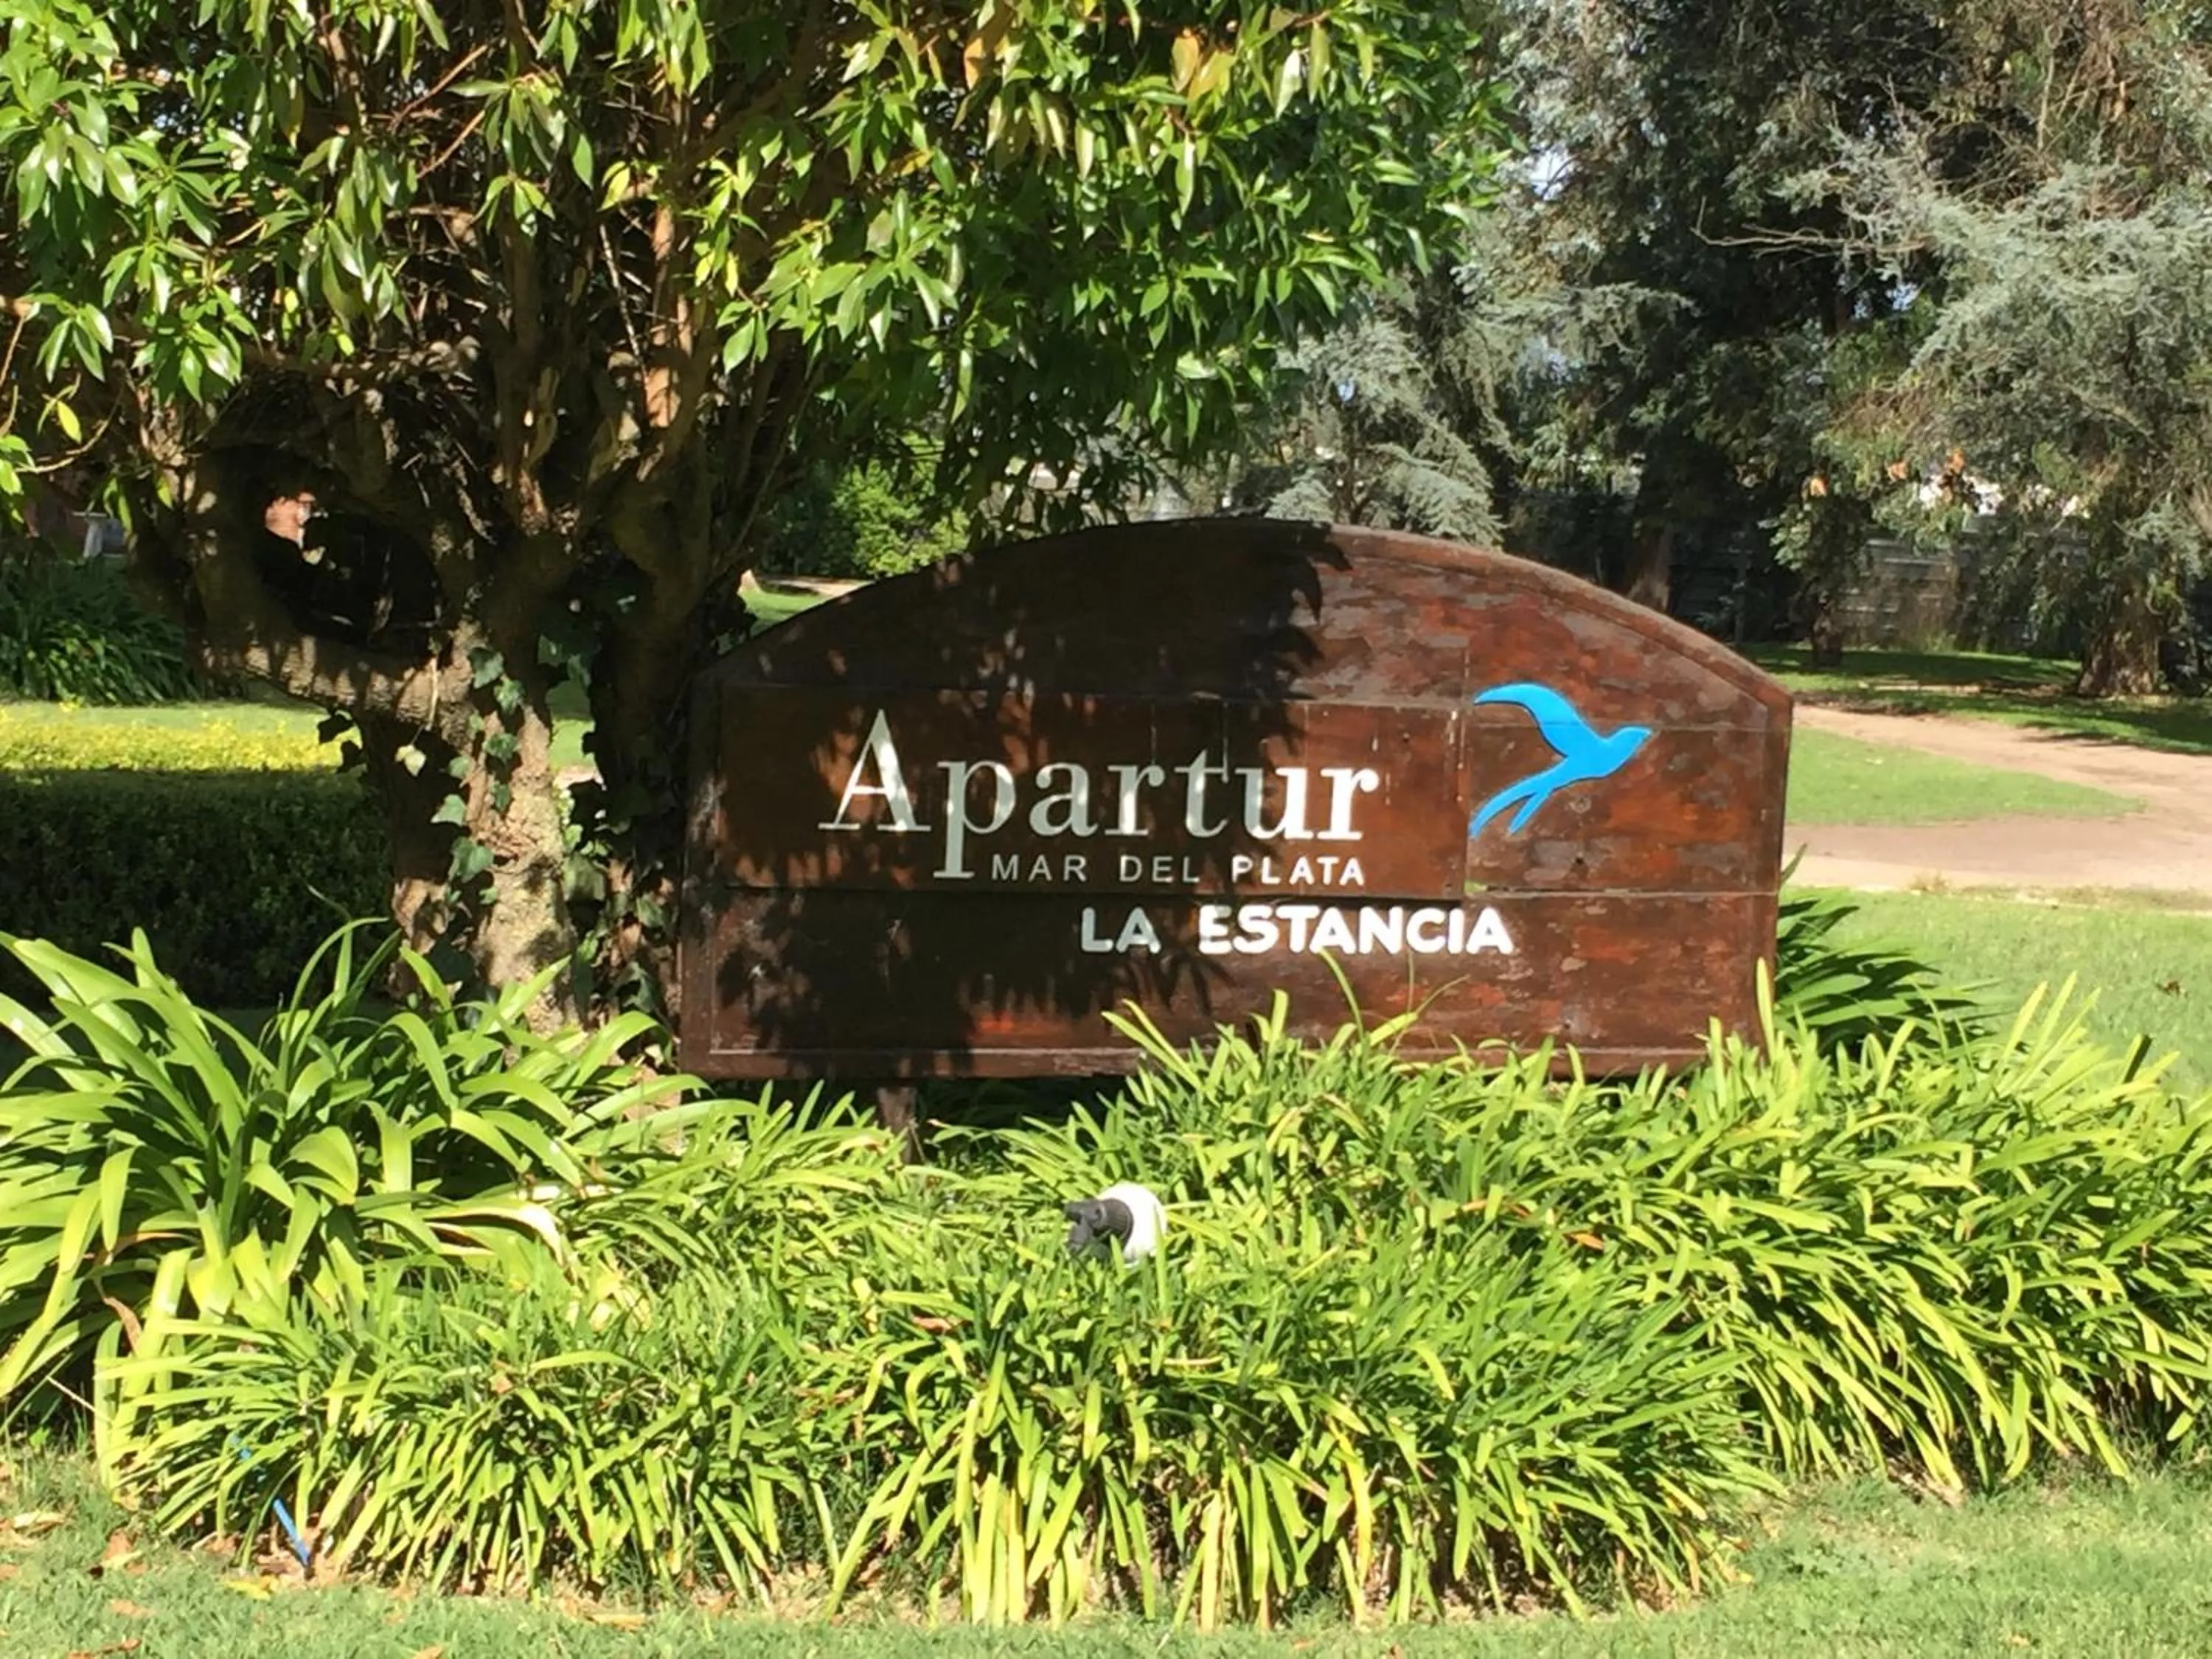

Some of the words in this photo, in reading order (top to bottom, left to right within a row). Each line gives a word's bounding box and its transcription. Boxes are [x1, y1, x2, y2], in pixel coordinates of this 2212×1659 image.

[818, 709, 1378, 879] Apartur
[991, 855, 1088, 883] MAR
[1121, 855, 1200, 884] DEL
[1231, 857, 1366, 886] PLATA
[1080, 906, 1161, 954] LA
[1198, 904, 1514, 956] ESTANCIA
